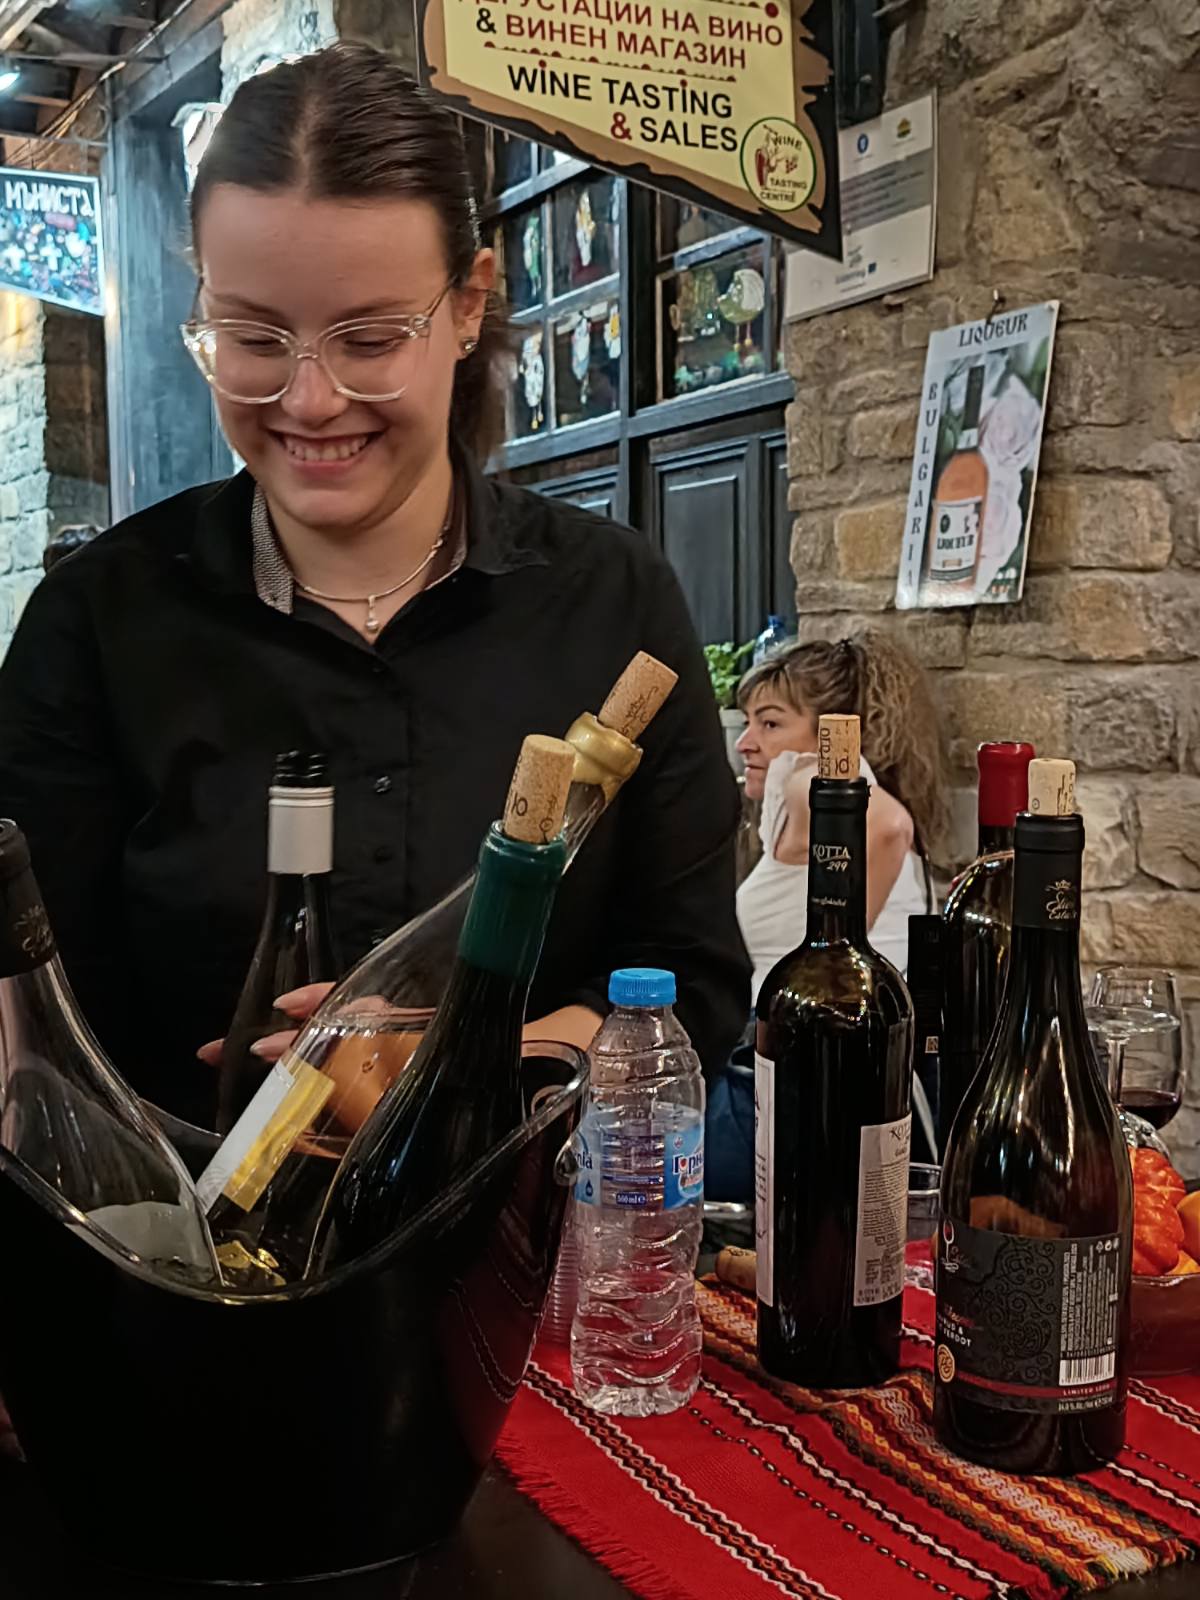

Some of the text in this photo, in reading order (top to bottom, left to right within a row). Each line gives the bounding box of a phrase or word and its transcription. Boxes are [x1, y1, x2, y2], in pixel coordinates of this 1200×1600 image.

[476, 8, 747, 69] & ВИНЕН МАГАЗИН
[661, 8, 699, 34] НА
[708, 16, 784, 46] ВИНО
[508, 60, 732, 118] WINE TASTING
[610, 111, 738, 152] & SALES
[770, 177, 807, 190] TASTING
[958, 313, 1029, 348] LIQUEUR
